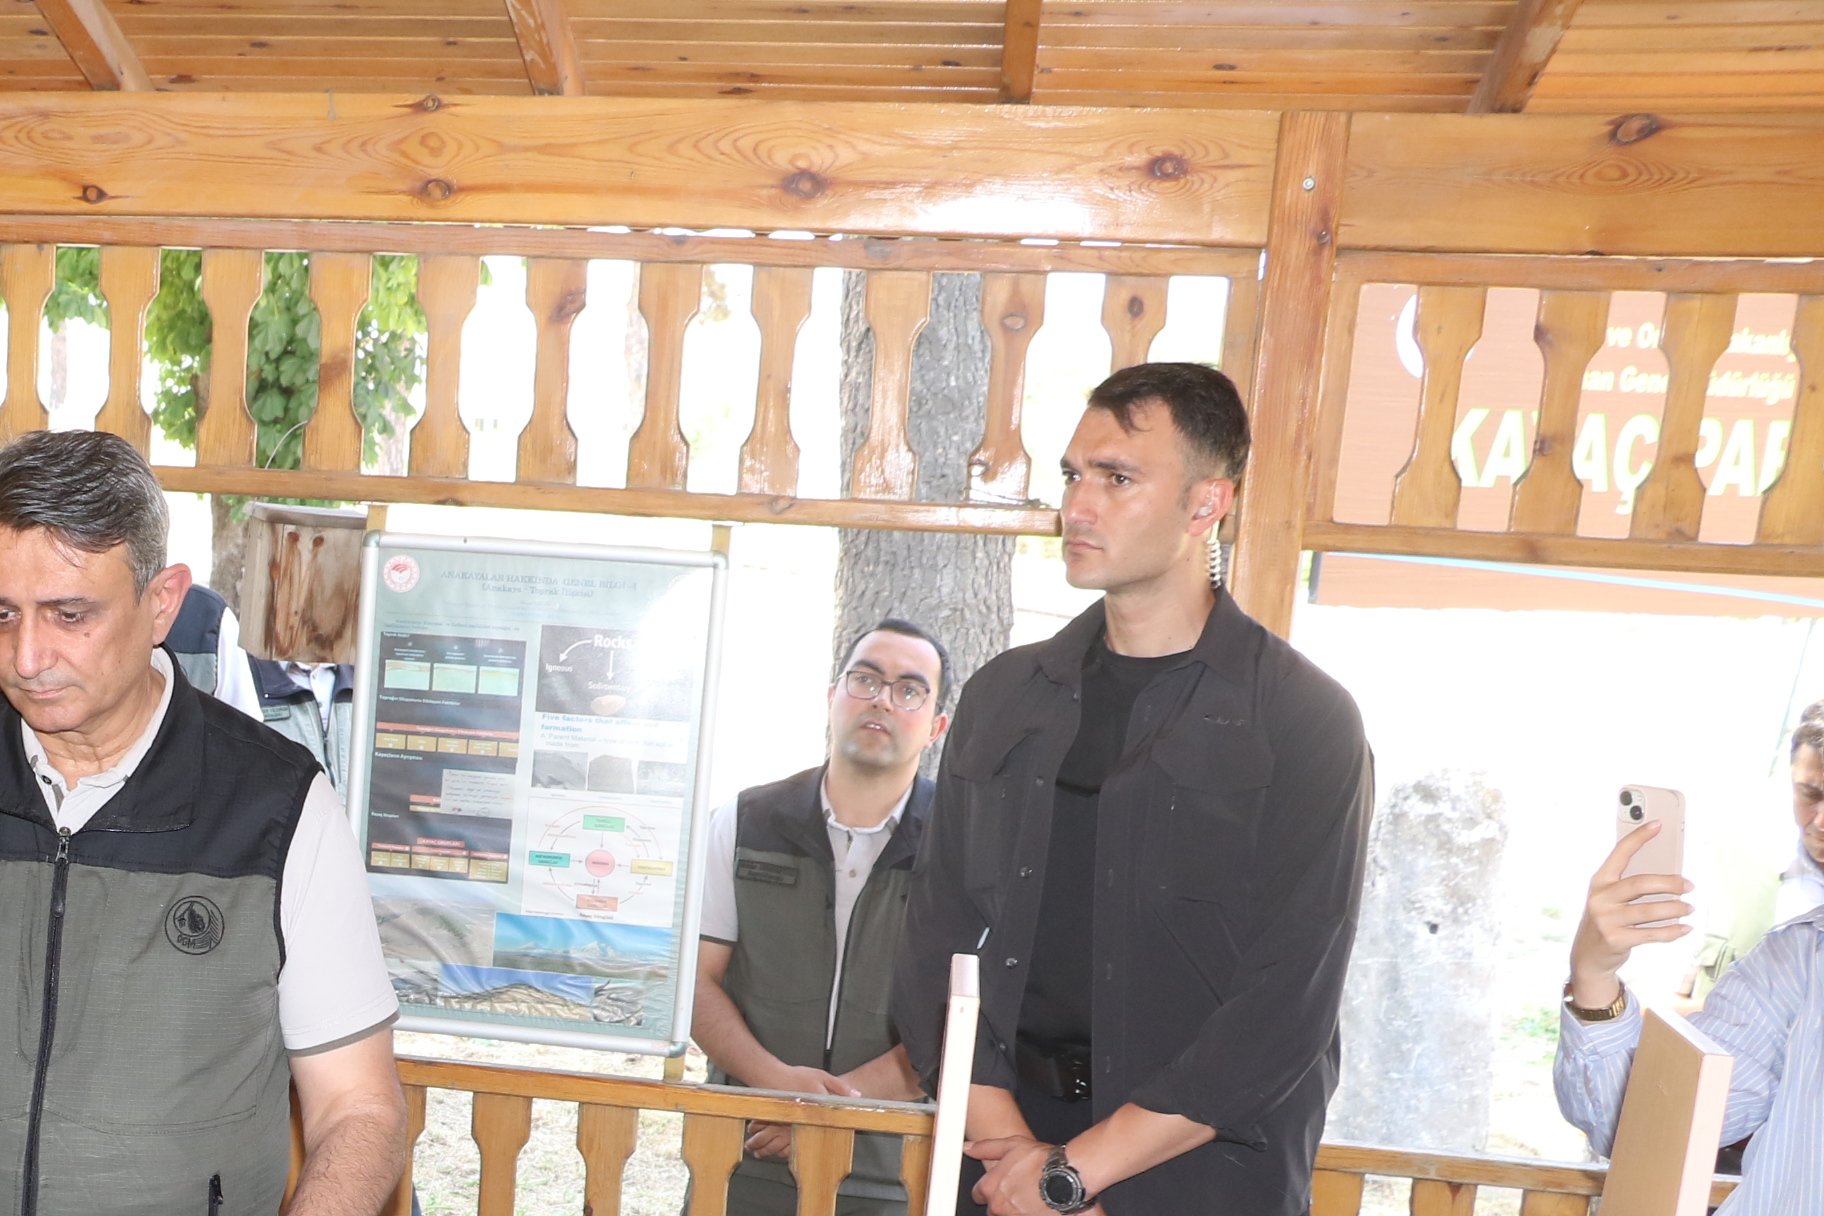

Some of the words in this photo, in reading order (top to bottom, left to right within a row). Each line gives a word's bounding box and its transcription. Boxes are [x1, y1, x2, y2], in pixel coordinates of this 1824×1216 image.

[593, 633, 633, 649] Rocks
[545, 662, 574, 674] Igneous
[541, 713, 560, 722] Five
[562, 715, 593, 723] factors
[541, 723, 582, 733] formation
